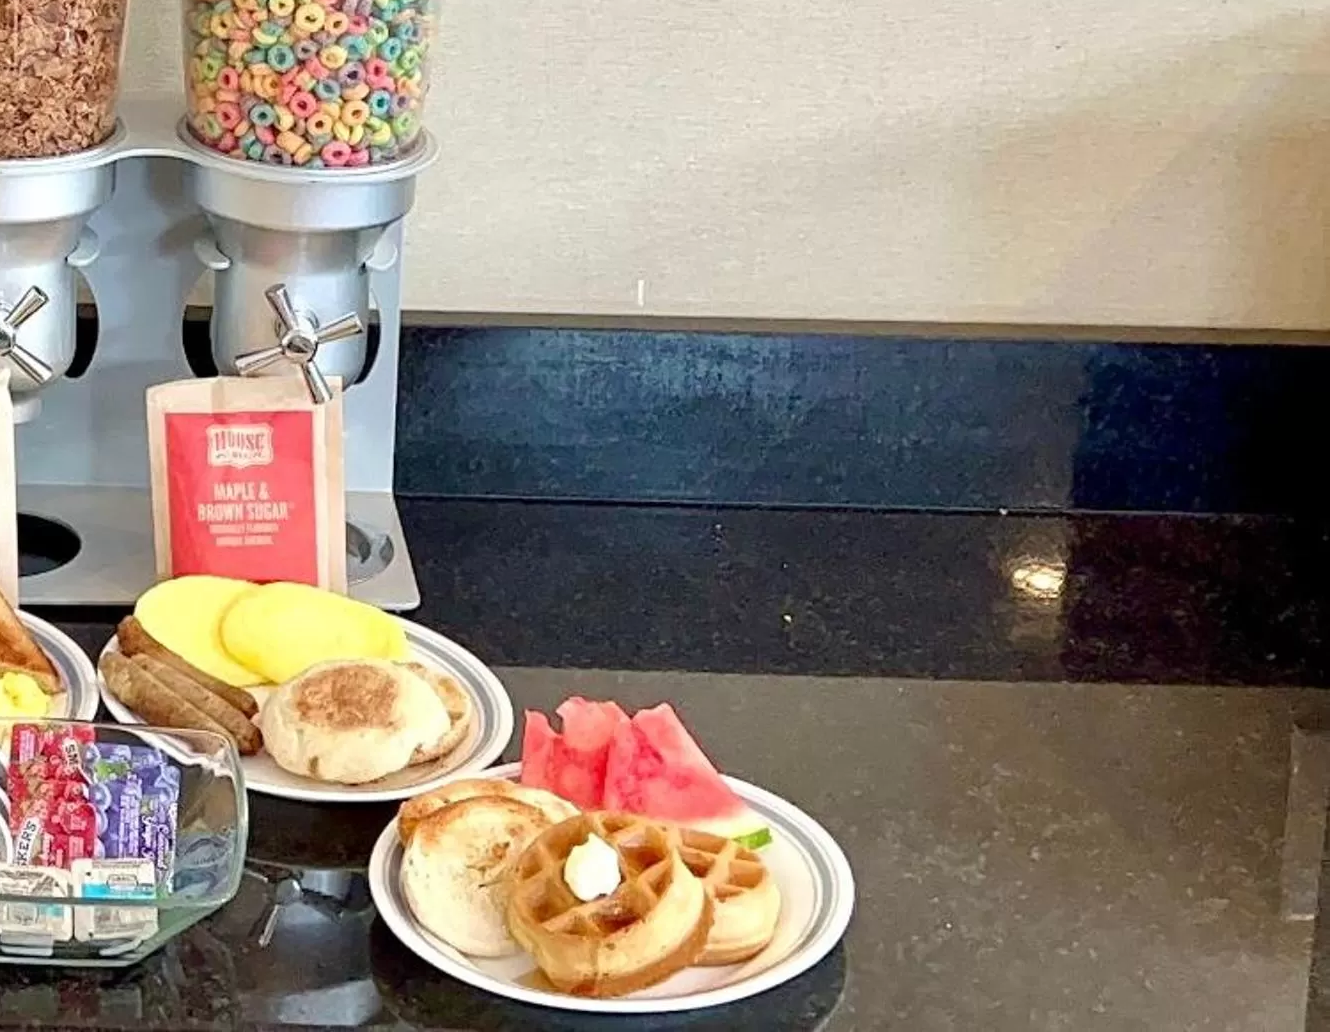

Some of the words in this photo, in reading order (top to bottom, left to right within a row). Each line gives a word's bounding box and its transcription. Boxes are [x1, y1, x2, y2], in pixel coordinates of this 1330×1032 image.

[213, 481, 255, 501] MAPLE
[258, 480, 270, 500] &
[197, 503, 243, 522] BROWN
[246, 501, 289, 521] SUGAR
